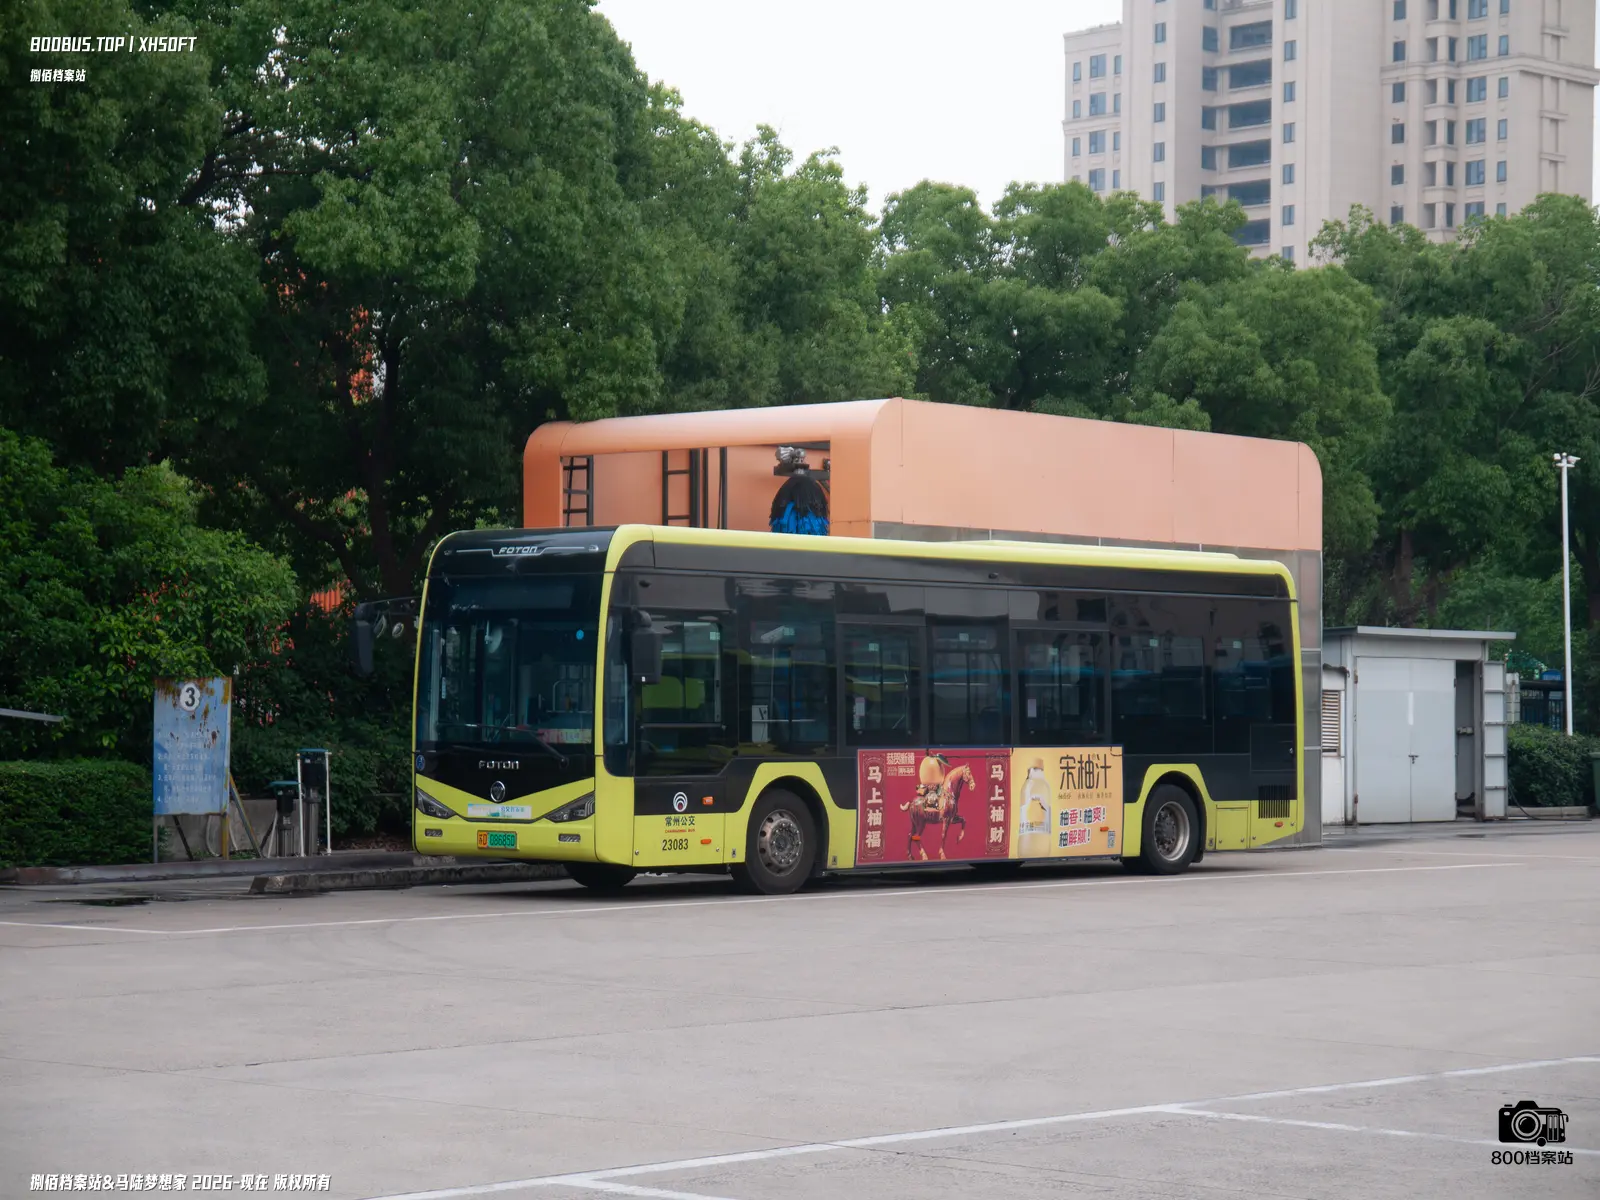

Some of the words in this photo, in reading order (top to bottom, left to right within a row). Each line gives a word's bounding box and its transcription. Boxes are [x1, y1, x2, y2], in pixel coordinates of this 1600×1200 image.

[499, 546, 538, 554] FOTON
[185, 687, 195, 707] 3
[479, 760, 520, 769] FOTON
[1060, 754, 1112, 789] 宋柚汁
[866, 765, 883, 848] 马上柚福
[990, 764, 1005, 843] 马上柚财
[665, 815, 696, 827] 常州公交
[662, 838, 689, 851] 23083
